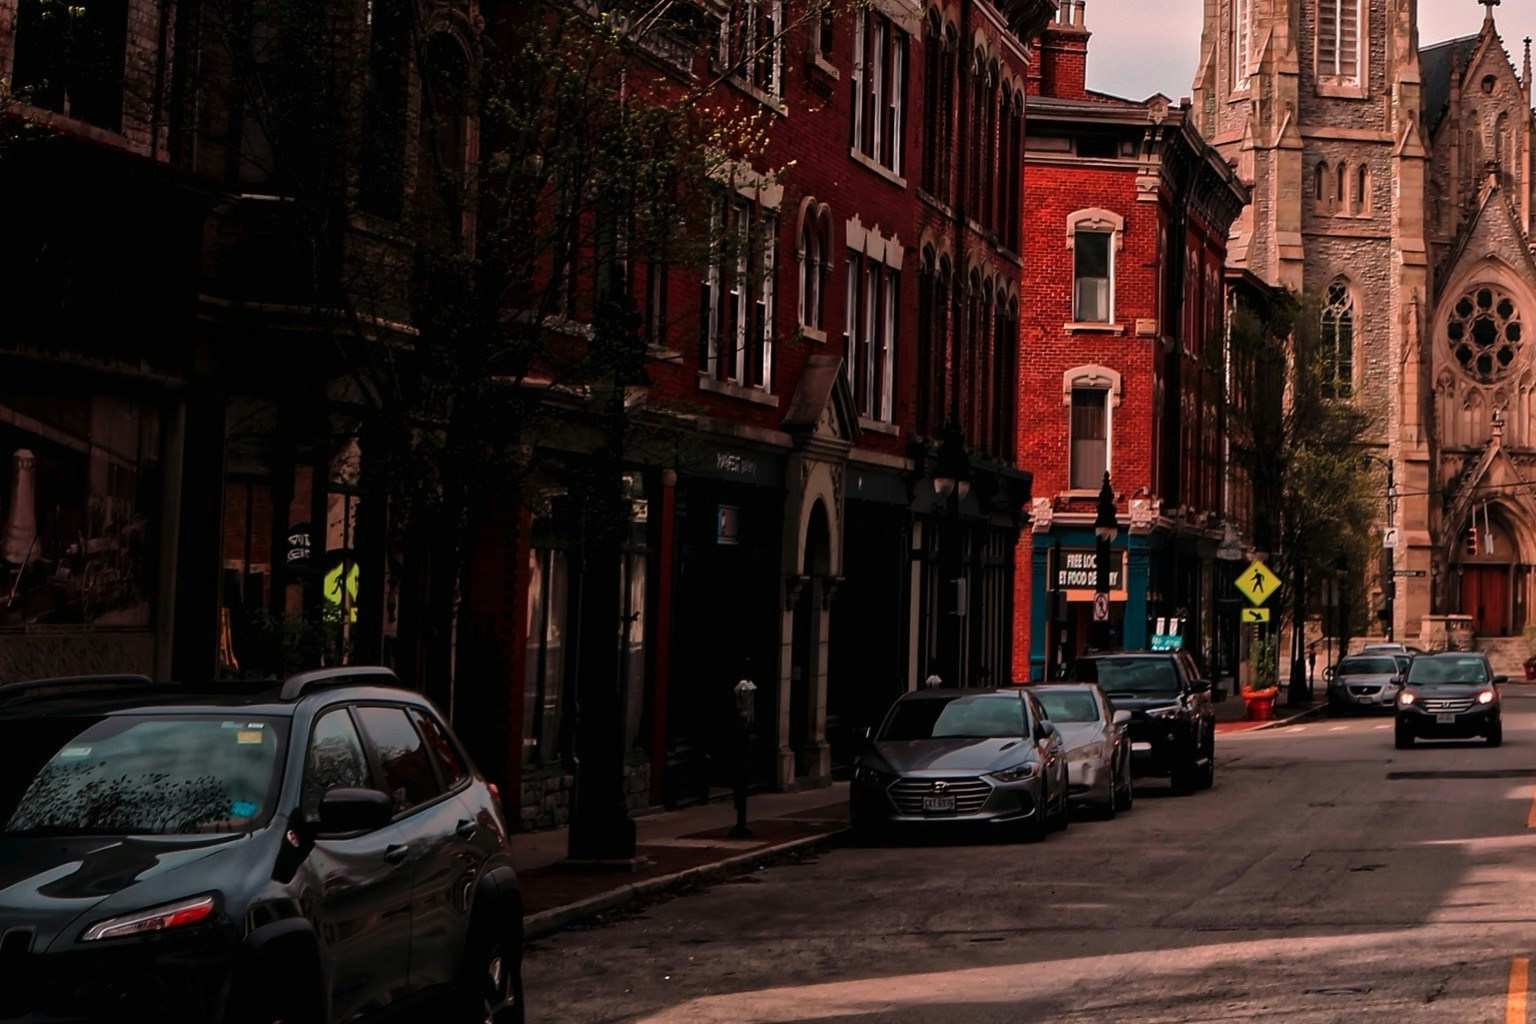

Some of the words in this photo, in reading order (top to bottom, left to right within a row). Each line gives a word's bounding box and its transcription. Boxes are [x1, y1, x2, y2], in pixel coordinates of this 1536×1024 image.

[1066, 554, 1082, 569] FREE
[1083, 554, 1097, 569] LOC
[1067, 571, 1087, 585] FOOD
